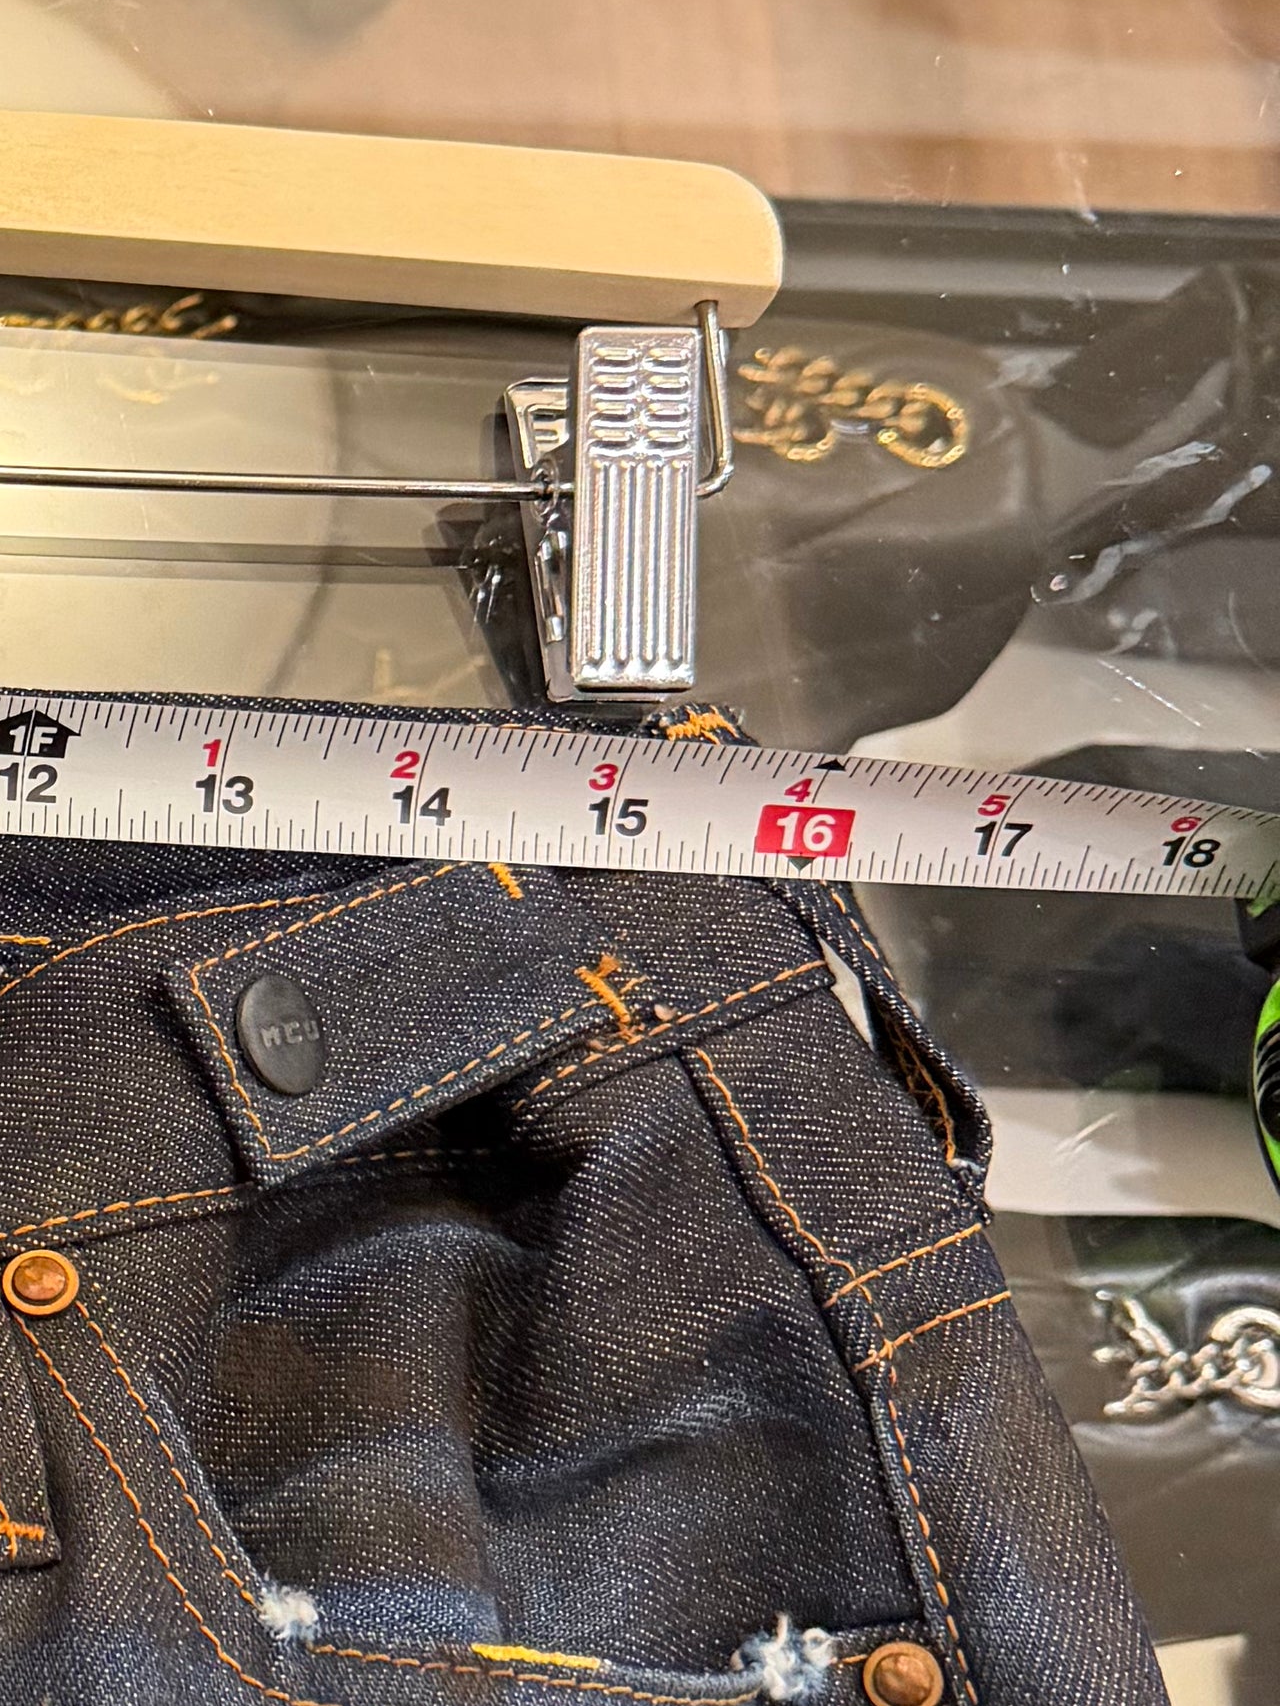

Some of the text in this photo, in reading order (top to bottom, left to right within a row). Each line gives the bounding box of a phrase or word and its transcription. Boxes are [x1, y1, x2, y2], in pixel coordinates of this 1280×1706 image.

[195, 773, 255, 815] 13
[391, 785, 453, 827] 14
[588, 796, 648, 837] 15
[775, 812, 836, 853] 16
[974, 821, 1033, 858] 17
[1161, 835, 1220, 869] 18
[202, 738, 1202, 833] 1 2 3 4 5 6
[260, 1019, 320, 1049] MCU
